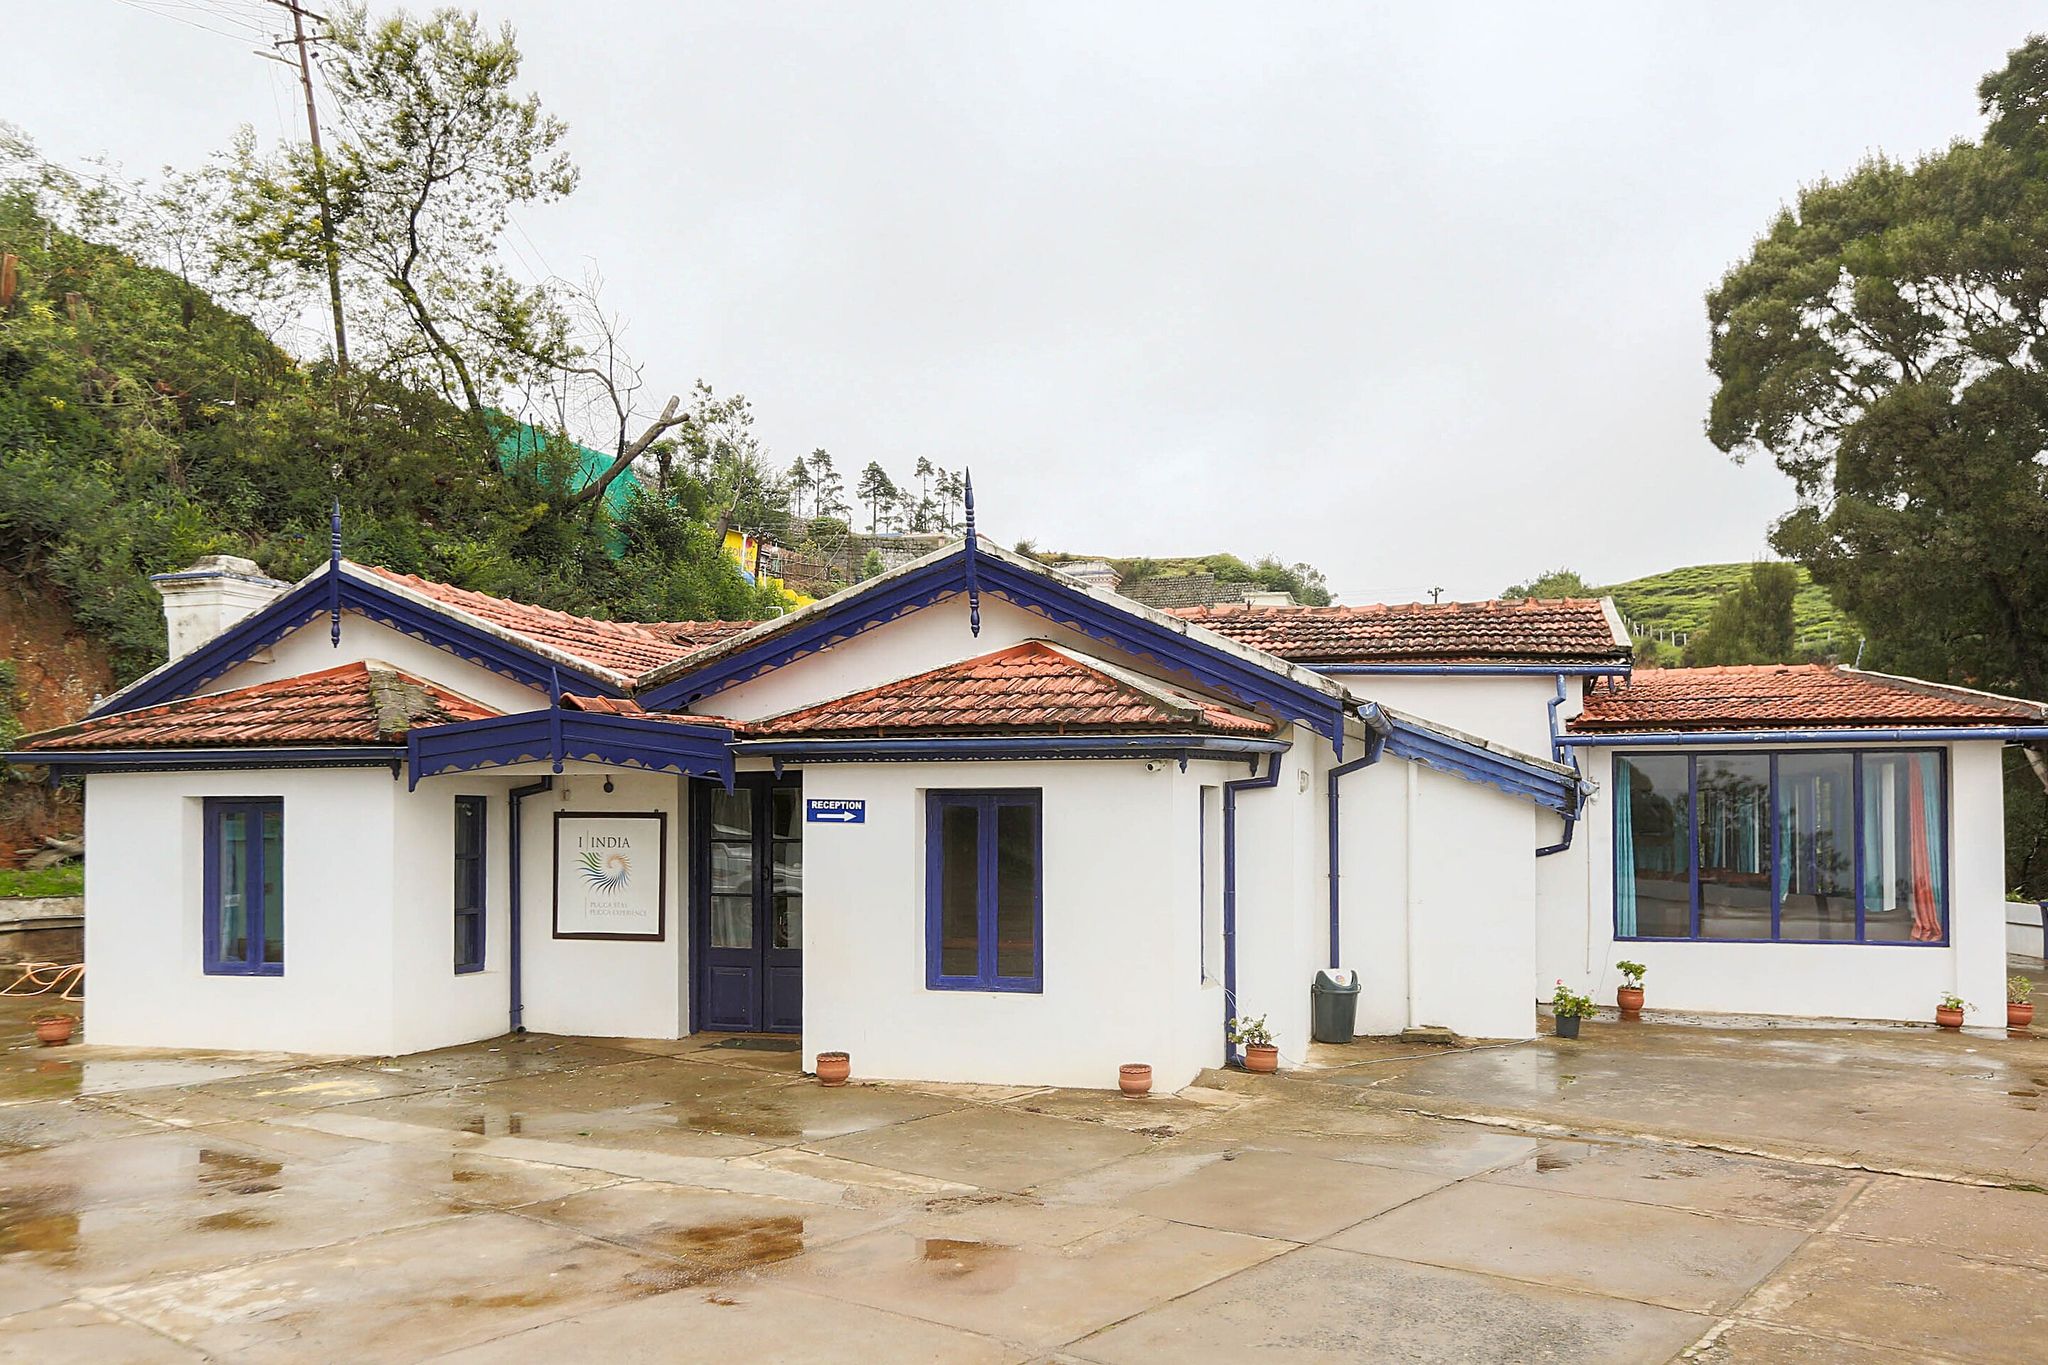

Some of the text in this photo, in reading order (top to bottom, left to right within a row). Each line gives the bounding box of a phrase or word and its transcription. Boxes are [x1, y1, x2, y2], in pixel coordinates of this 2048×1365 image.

[811, 801, 862, 810] RECEPTION
[578, 836, 630, 848] I INDIA
